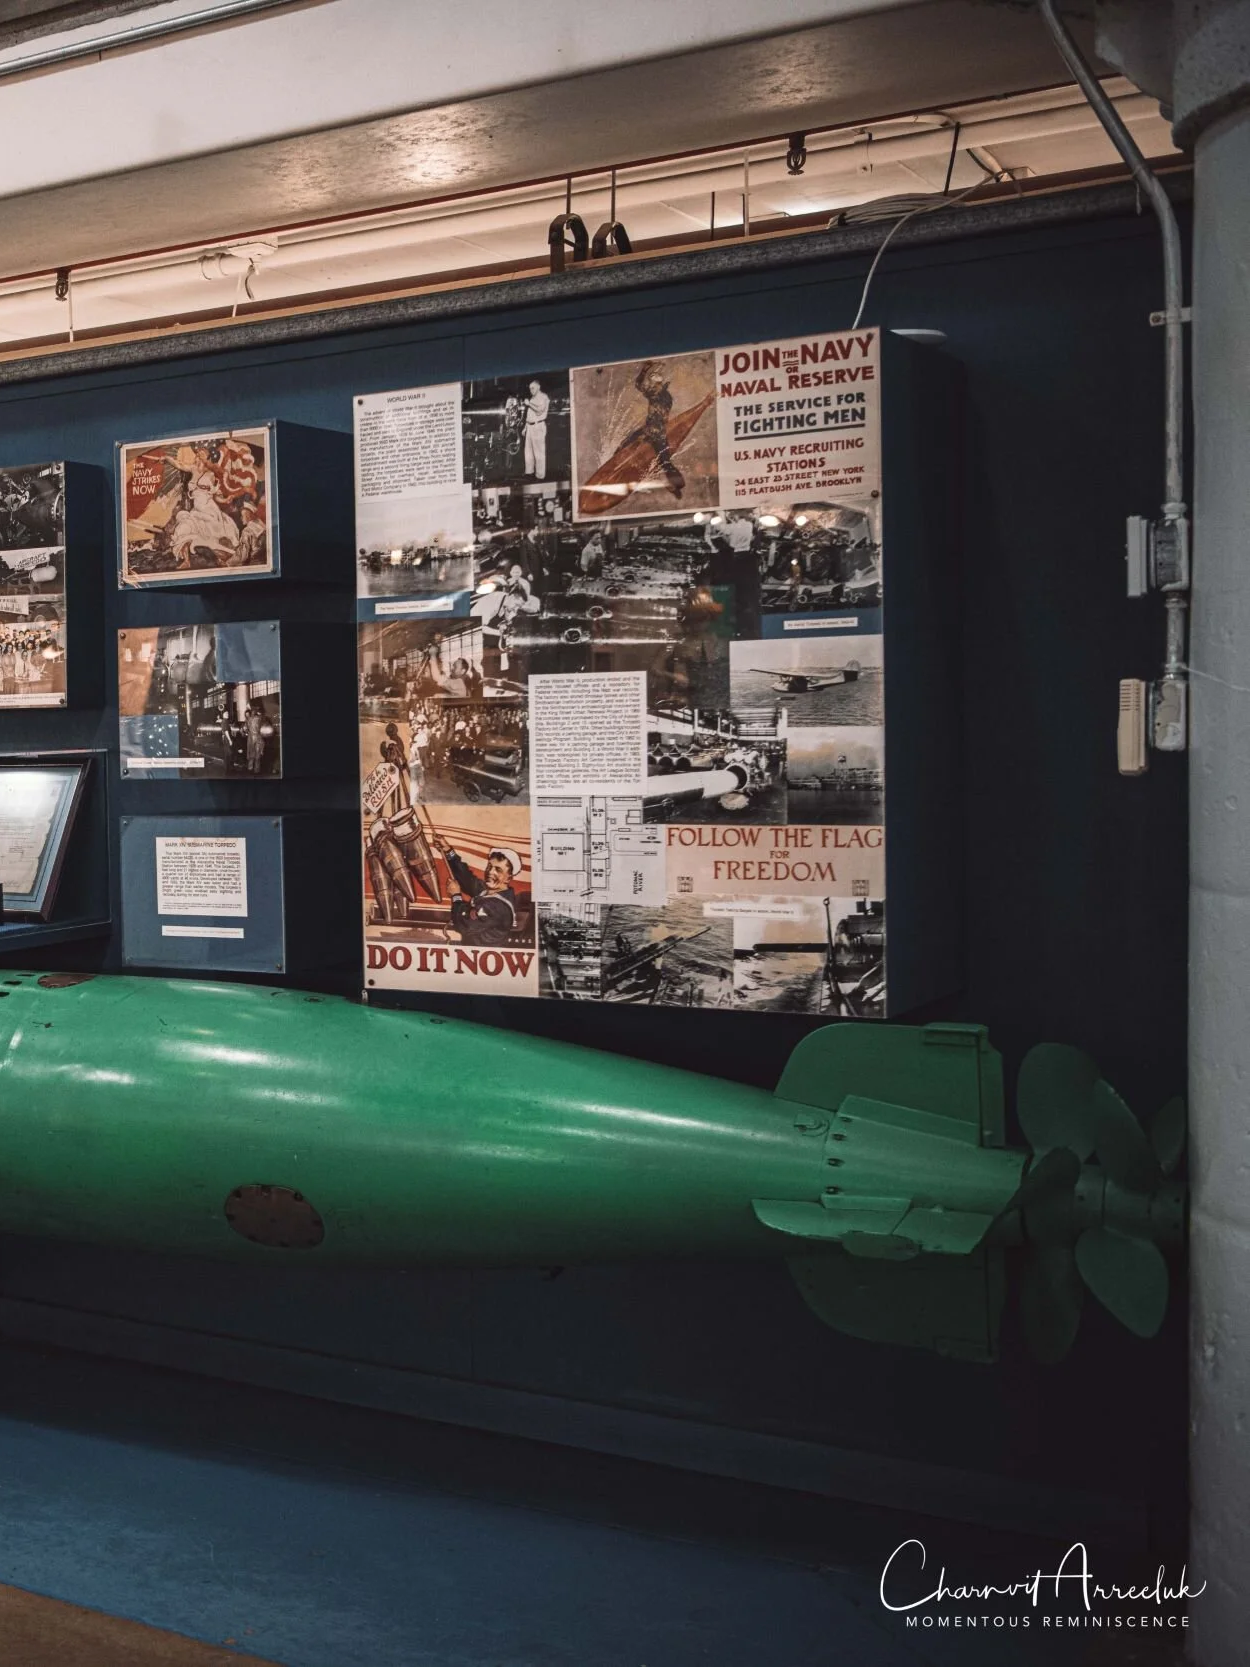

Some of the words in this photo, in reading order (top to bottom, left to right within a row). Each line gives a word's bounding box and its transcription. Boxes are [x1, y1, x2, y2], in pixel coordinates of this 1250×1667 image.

[719, 347, 780, 376] JOIN
[782, 349, 799, 359] THE
[800, 332, 875, 365] NAVY
[785, 366, 799, 374] OR
[720, 377, 782, 398] NAVAL
[788, 365, 875, 390] RESERVE
[734, 404, 763, 417] THE
[768, 395, 831, 413] SERVICE
[836, 392, 866, 405] FOR
[734, 413, 817, 435] FIGHTING
[823, 407, 866, 425] MEN
[734, 450, 752, 461] U.S.
[753, 446, 787, 459] NAVY
[790, 437, 864, 456] RECRUITING
[133, 468, 153, 477] NAVY
[748, 475, 770, 485] EAST
[784, 470, 819, 482] STREET
[821, 468, 840, 477] NEW
[842, 465, 865, 475] YORK
[766, 457, 826, 473] STATIONS
[132, 474, 161, 486] STRIKES
[132, 485, 156, 495] NOW
[735, 488, 747, 496] 115
[749, 484, 792, 495] FLATBUSH
[815, 476, 862, 488] BROOKLYN
[666, 826, 762, 848] FOLLOW
[769, 827, 814, 849] THE
[820, 828, 884, 849] FLAG
[769, 850, 790, 859] FOR
[713, 860, 838, 882] FREEDOM
[366, 944, 412, 971] DO
[416, 946, 450, 974] IT
[453, 950, 536, 978] NOW
